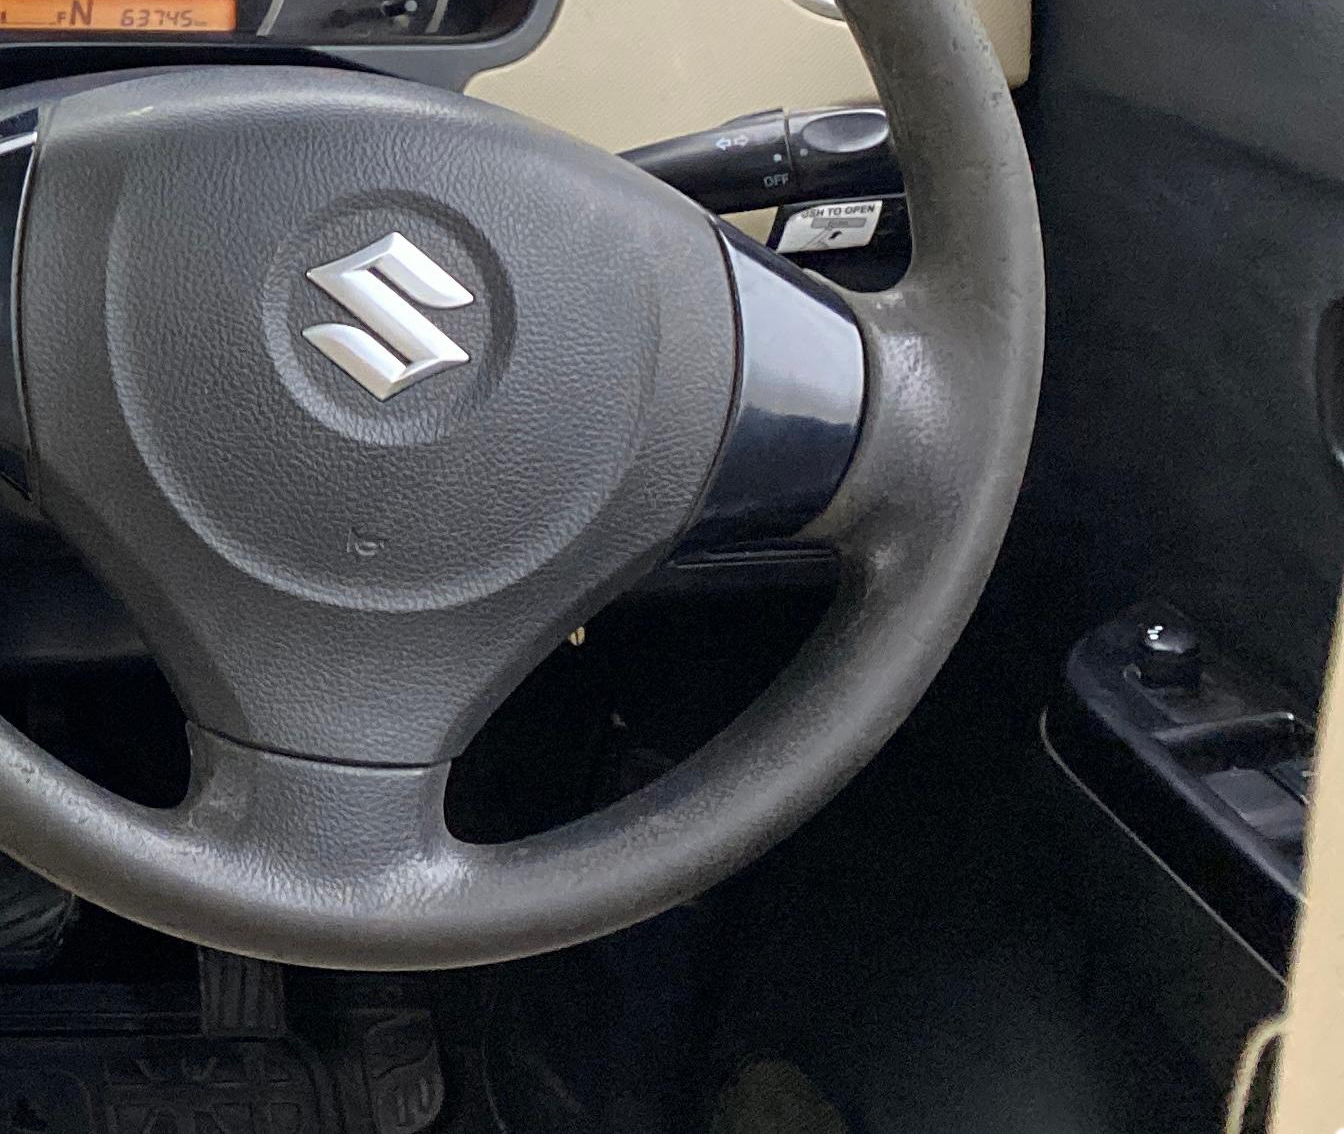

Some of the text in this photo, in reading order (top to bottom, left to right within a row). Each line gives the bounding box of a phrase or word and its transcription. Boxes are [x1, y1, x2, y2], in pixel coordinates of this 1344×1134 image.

[69, 0, 94, 26] N
[120, 8, 193, 27] 63745
[764, 174, 789, 187] OFF
[828, 207, 842, 217] TO
[845, 205, 875, 215] OPEN
